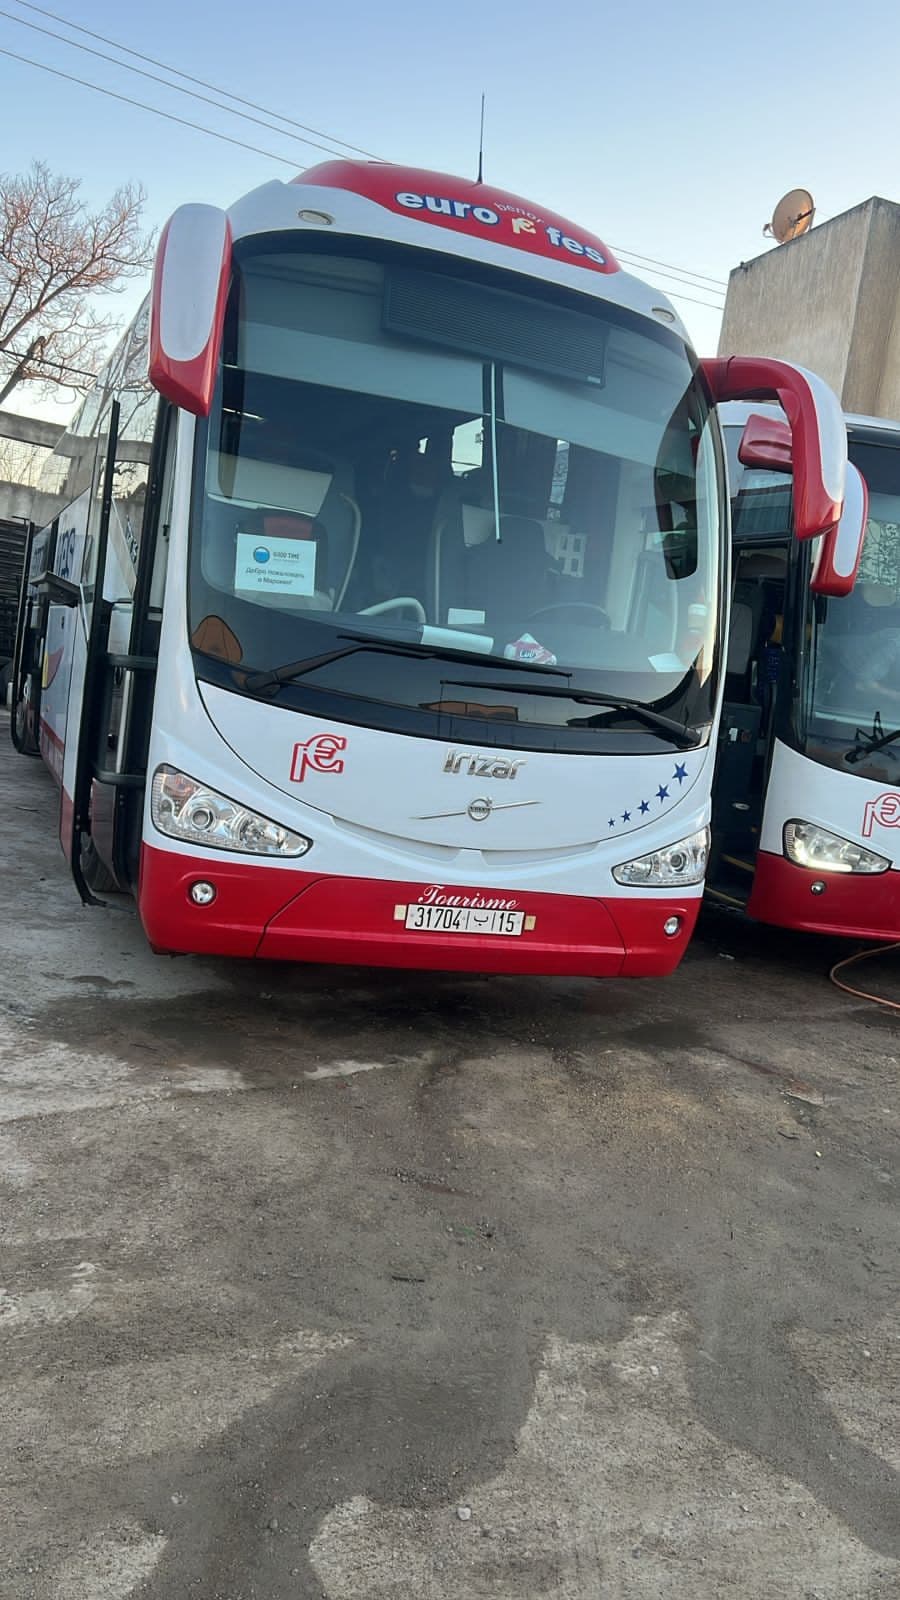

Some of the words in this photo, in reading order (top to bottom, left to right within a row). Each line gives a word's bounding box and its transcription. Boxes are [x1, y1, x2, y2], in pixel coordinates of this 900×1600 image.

[394, 191, 500, 226] euro
[545, 225, 608, 266] fes
[417, 884, 520, 910] Tourisme
[414, 906, 463, 930] 31704
[498, 911, 517, 933] 15
